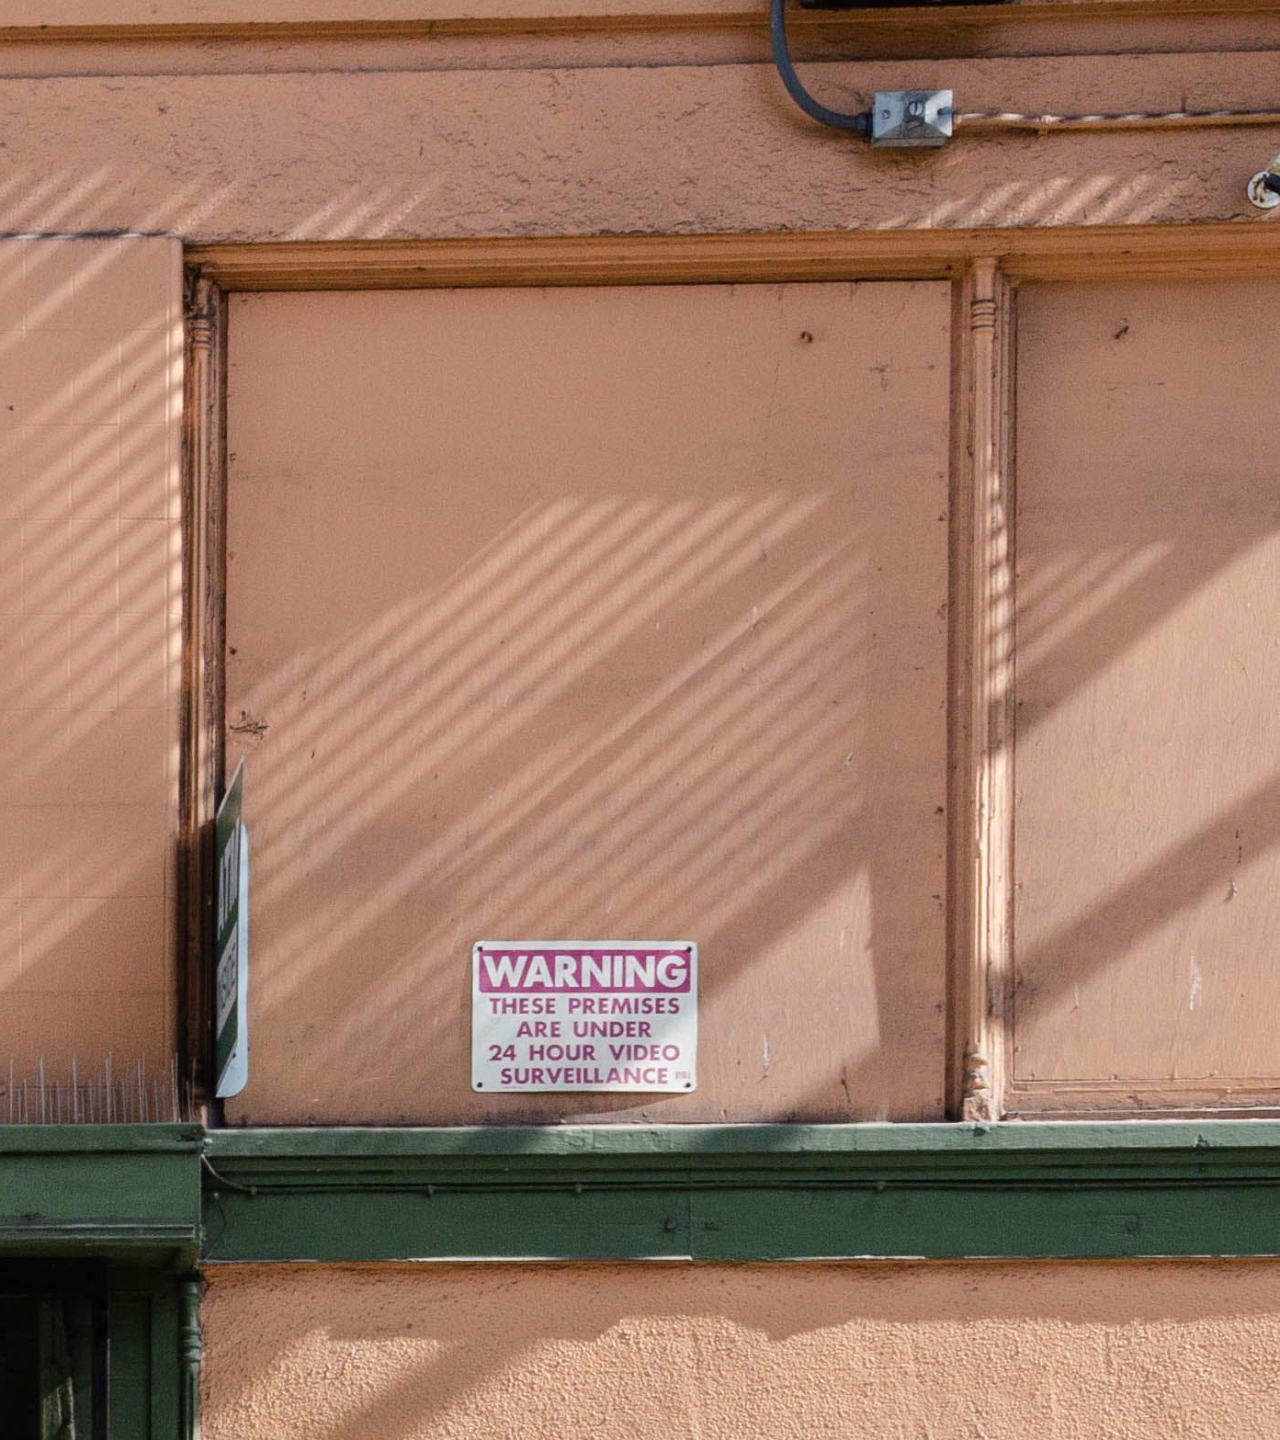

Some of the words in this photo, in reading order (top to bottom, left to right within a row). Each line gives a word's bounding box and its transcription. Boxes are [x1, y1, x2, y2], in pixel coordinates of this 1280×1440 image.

[482, 954, 688, 989] WARNING
[489, 997, 556, 1015] THESE
[568, 997, 680, 1015] PREMISES
[516, 1021, 561, 1038] ARE
[573, 1021, 652, 1038] UNDER
[488, 1044, 517, 1062] 24
[529, 1044, 596, 1062] HOUR
[609, 1044, 680, 1062] VIDEO
[500, 1067, 669, 1085] SURVEILLANCE
